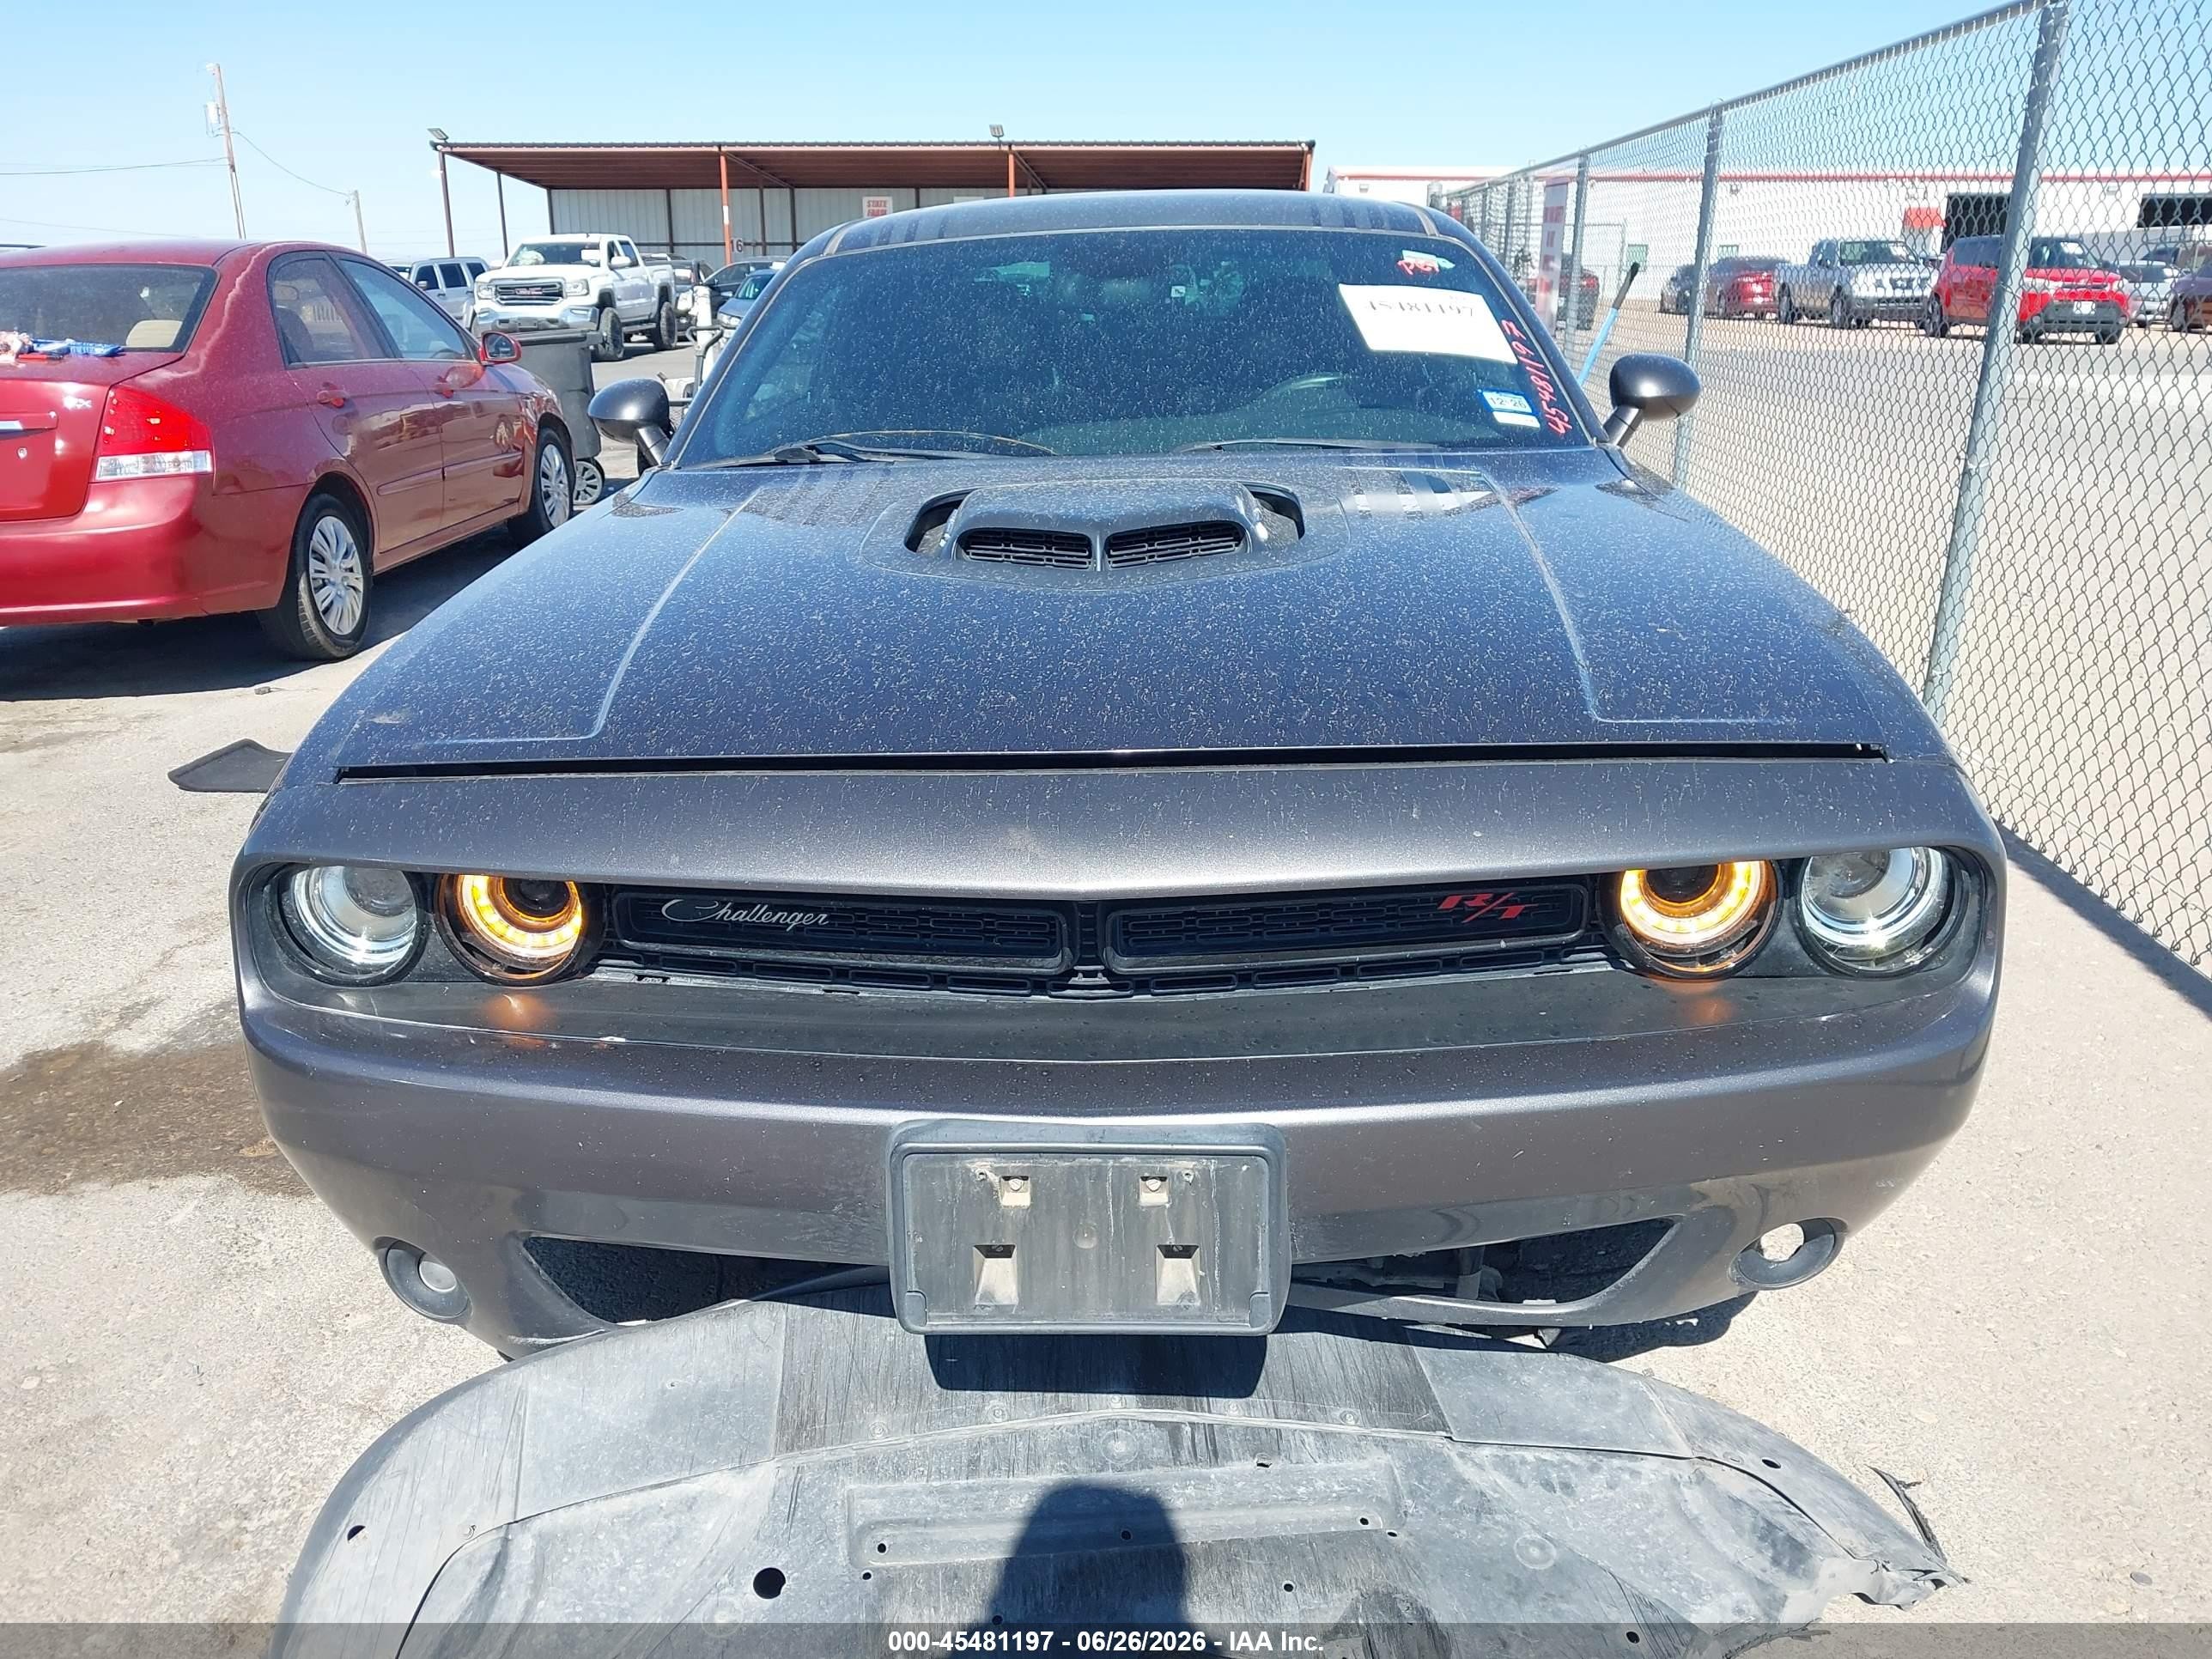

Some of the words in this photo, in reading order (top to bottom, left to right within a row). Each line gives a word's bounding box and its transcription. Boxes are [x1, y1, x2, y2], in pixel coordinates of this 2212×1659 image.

[730, 239, 743, 252] 16
[661, 898, 830, 932] Challenger
[1437, 892, 1539, 924] R/T
